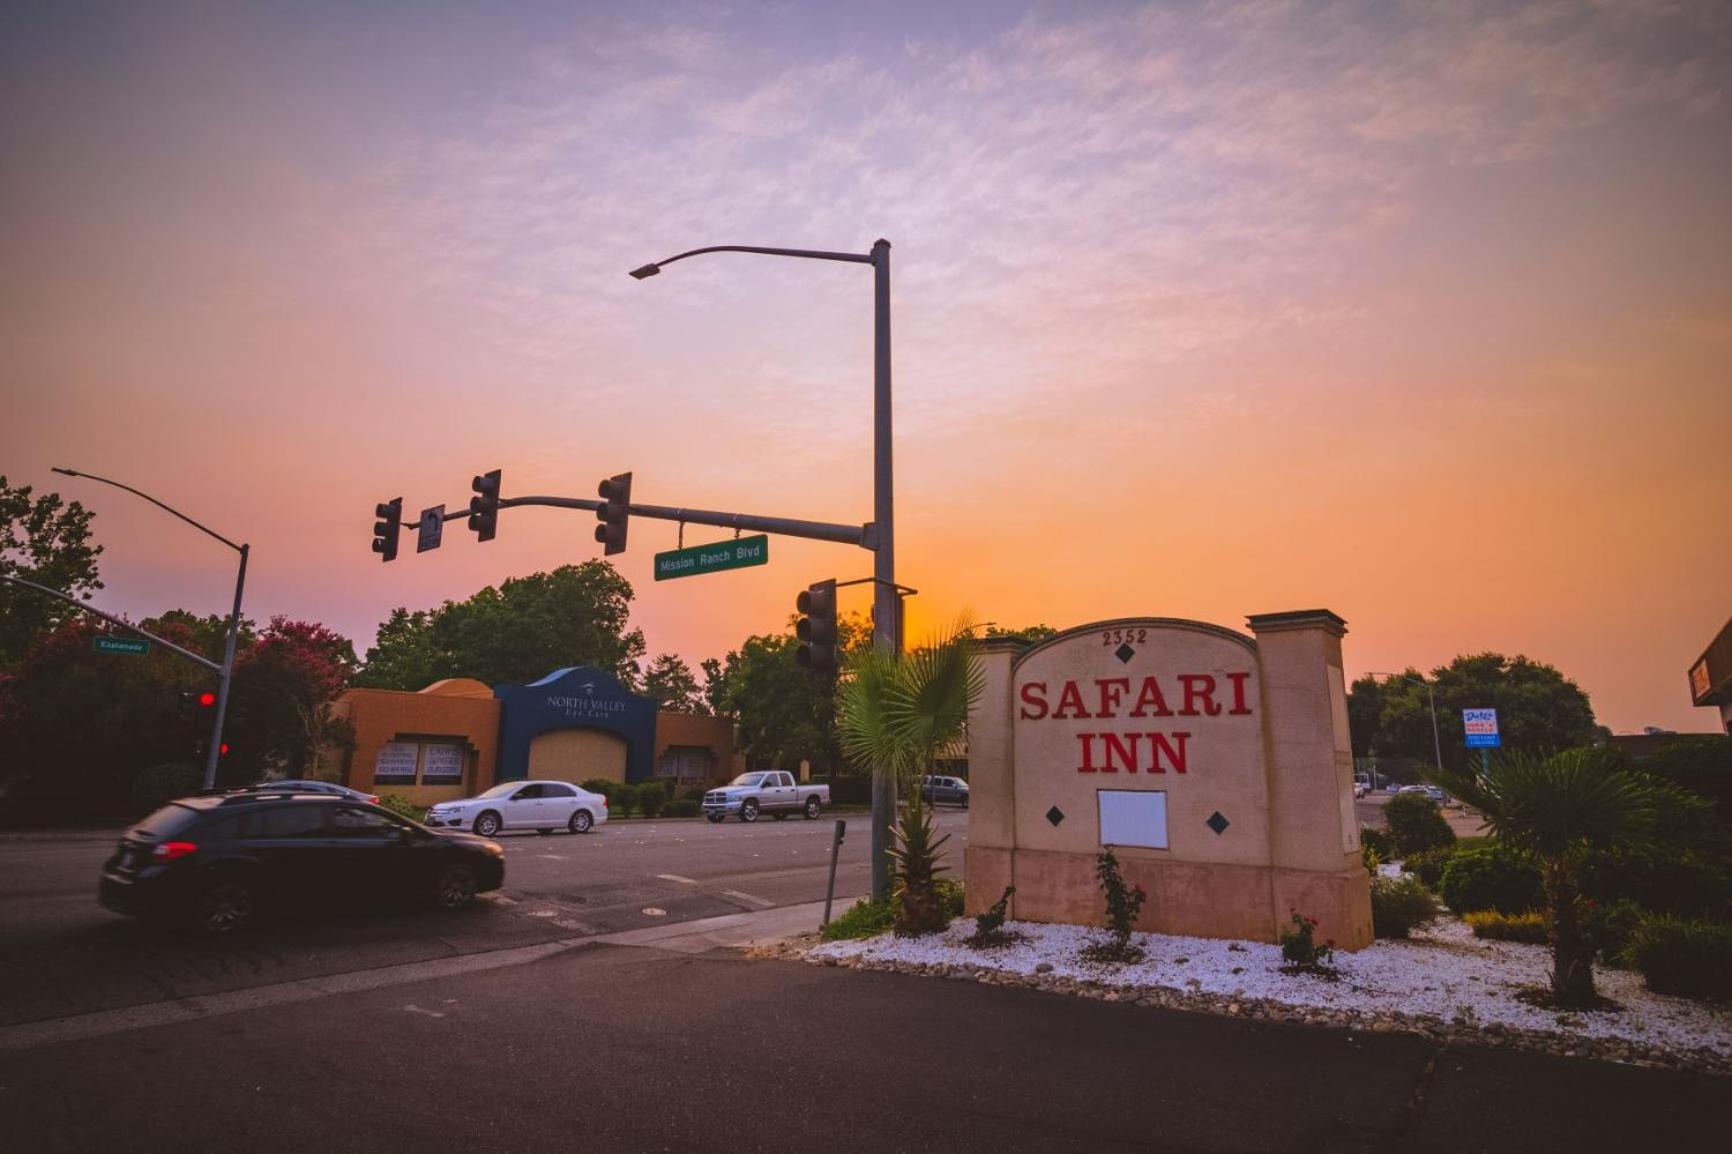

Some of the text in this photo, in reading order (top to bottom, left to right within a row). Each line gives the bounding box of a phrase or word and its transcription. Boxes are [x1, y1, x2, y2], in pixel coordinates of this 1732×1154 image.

[660, 545, 760, 572] Mission Ranch Blvd
[1102, 628, 1147, 646] 2352
[547, 696, 626, 712] NORTH VALLEY
[1020, 671, 1253, 720] SAFARI
[1076, 732, 1191, 774] INN
